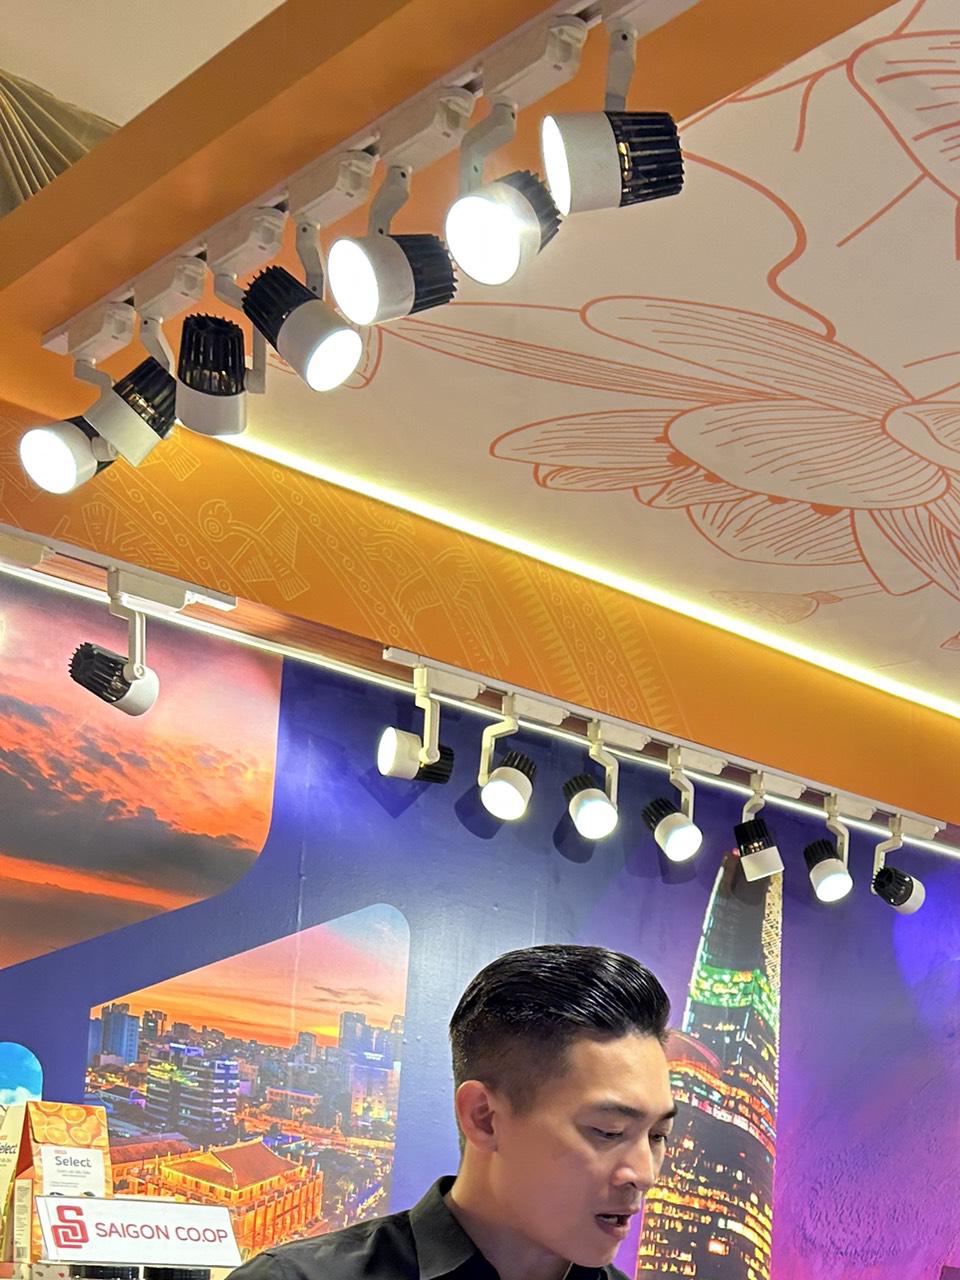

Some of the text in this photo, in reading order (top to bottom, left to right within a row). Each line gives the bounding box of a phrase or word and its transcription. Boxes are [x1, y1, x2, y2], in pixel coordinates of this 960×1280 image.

[55, 1155, 92, 1168] Select
[95, 1222, 228, 1243] SAIGON CO.OP
